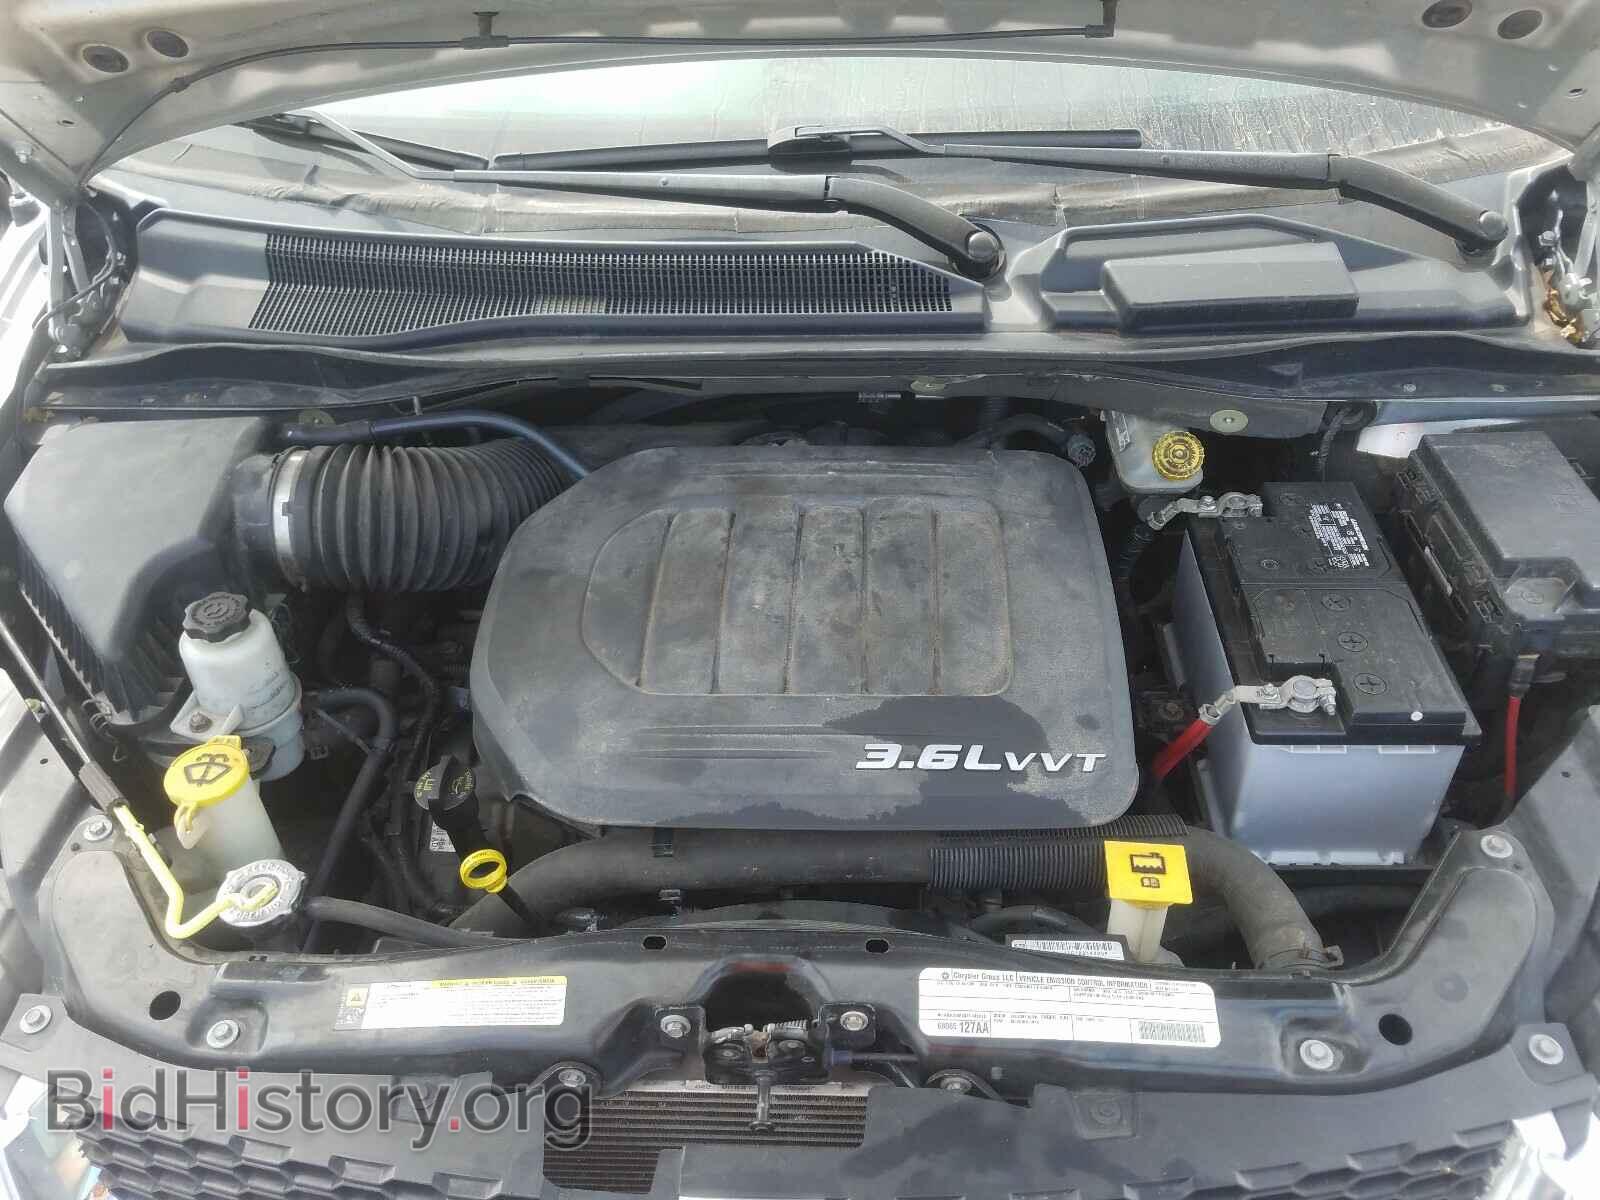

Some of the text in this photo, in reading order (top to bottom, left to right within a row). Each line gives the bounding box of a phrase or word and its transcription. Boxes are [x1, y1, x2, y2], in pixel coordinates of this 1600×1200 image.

[1002, 973, 1014, 982] LLC
[1018, 974, 1044, 984] VEHICLE
[1046, 976, 1075, 985] EMISSION
[1077, 978, 1105, 988] CONTROL
[1106, 979, 1149, 990] INFORMATION
[959, 1021, 990, 1034] 127AA
